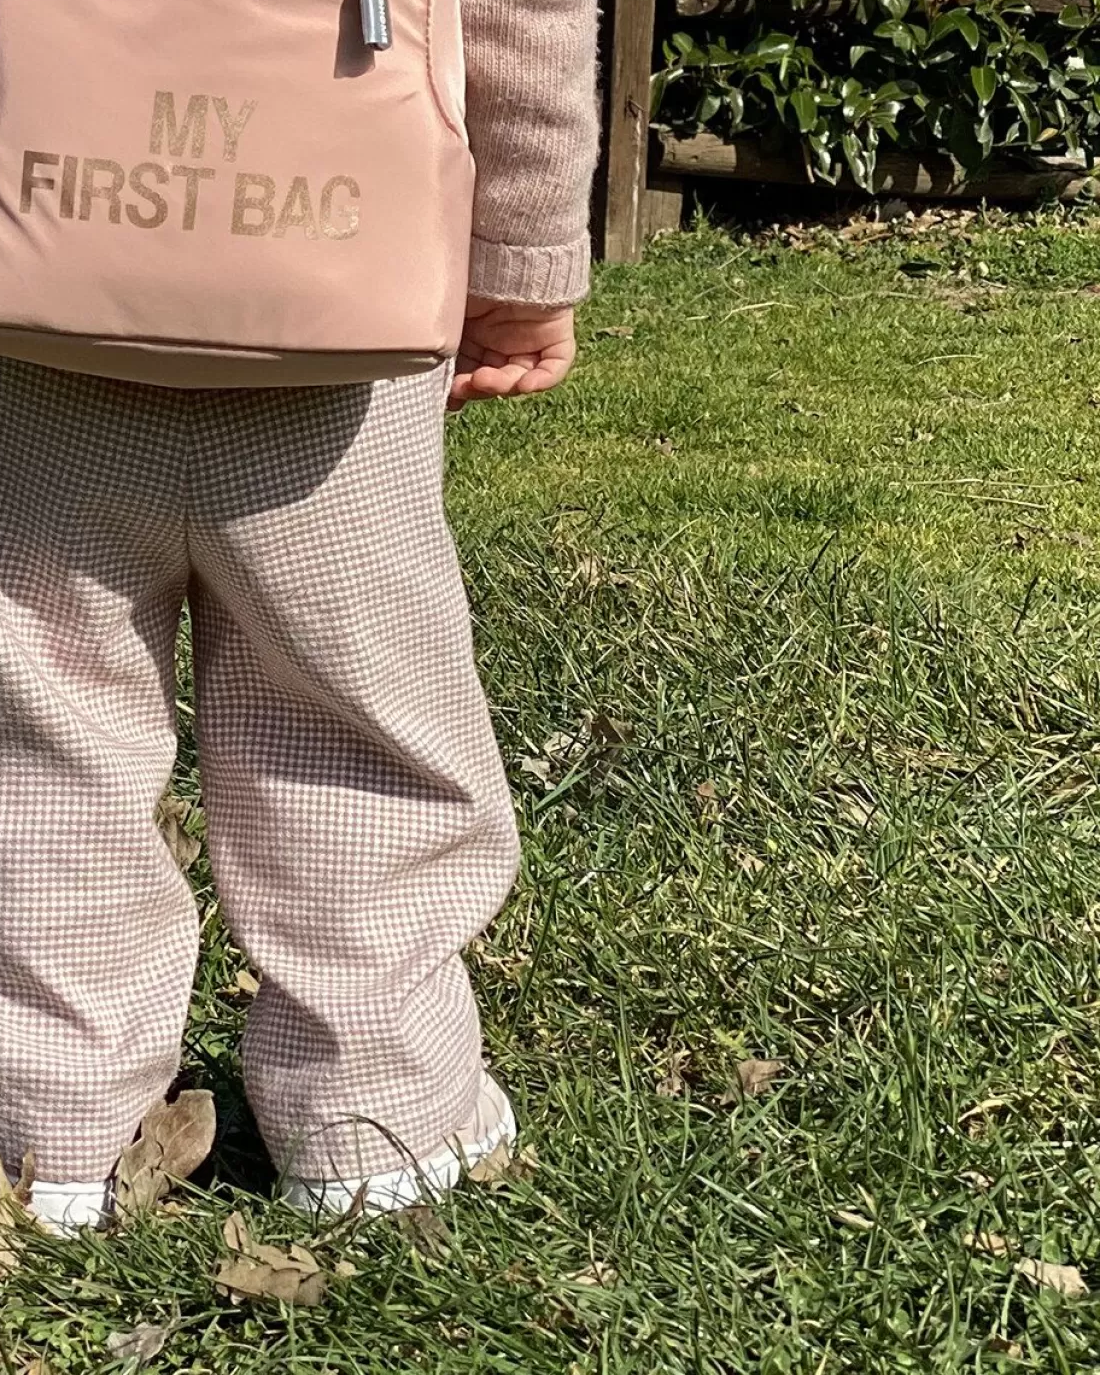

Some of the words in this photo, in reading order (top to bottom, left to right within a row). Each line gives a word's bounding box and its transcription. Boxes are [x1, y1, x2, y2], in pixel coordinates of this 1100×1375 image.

[148, 90, 259, 163] MY
[19, 150, 216, 231] FIRST
[230, 172, 361, 242] BAG
